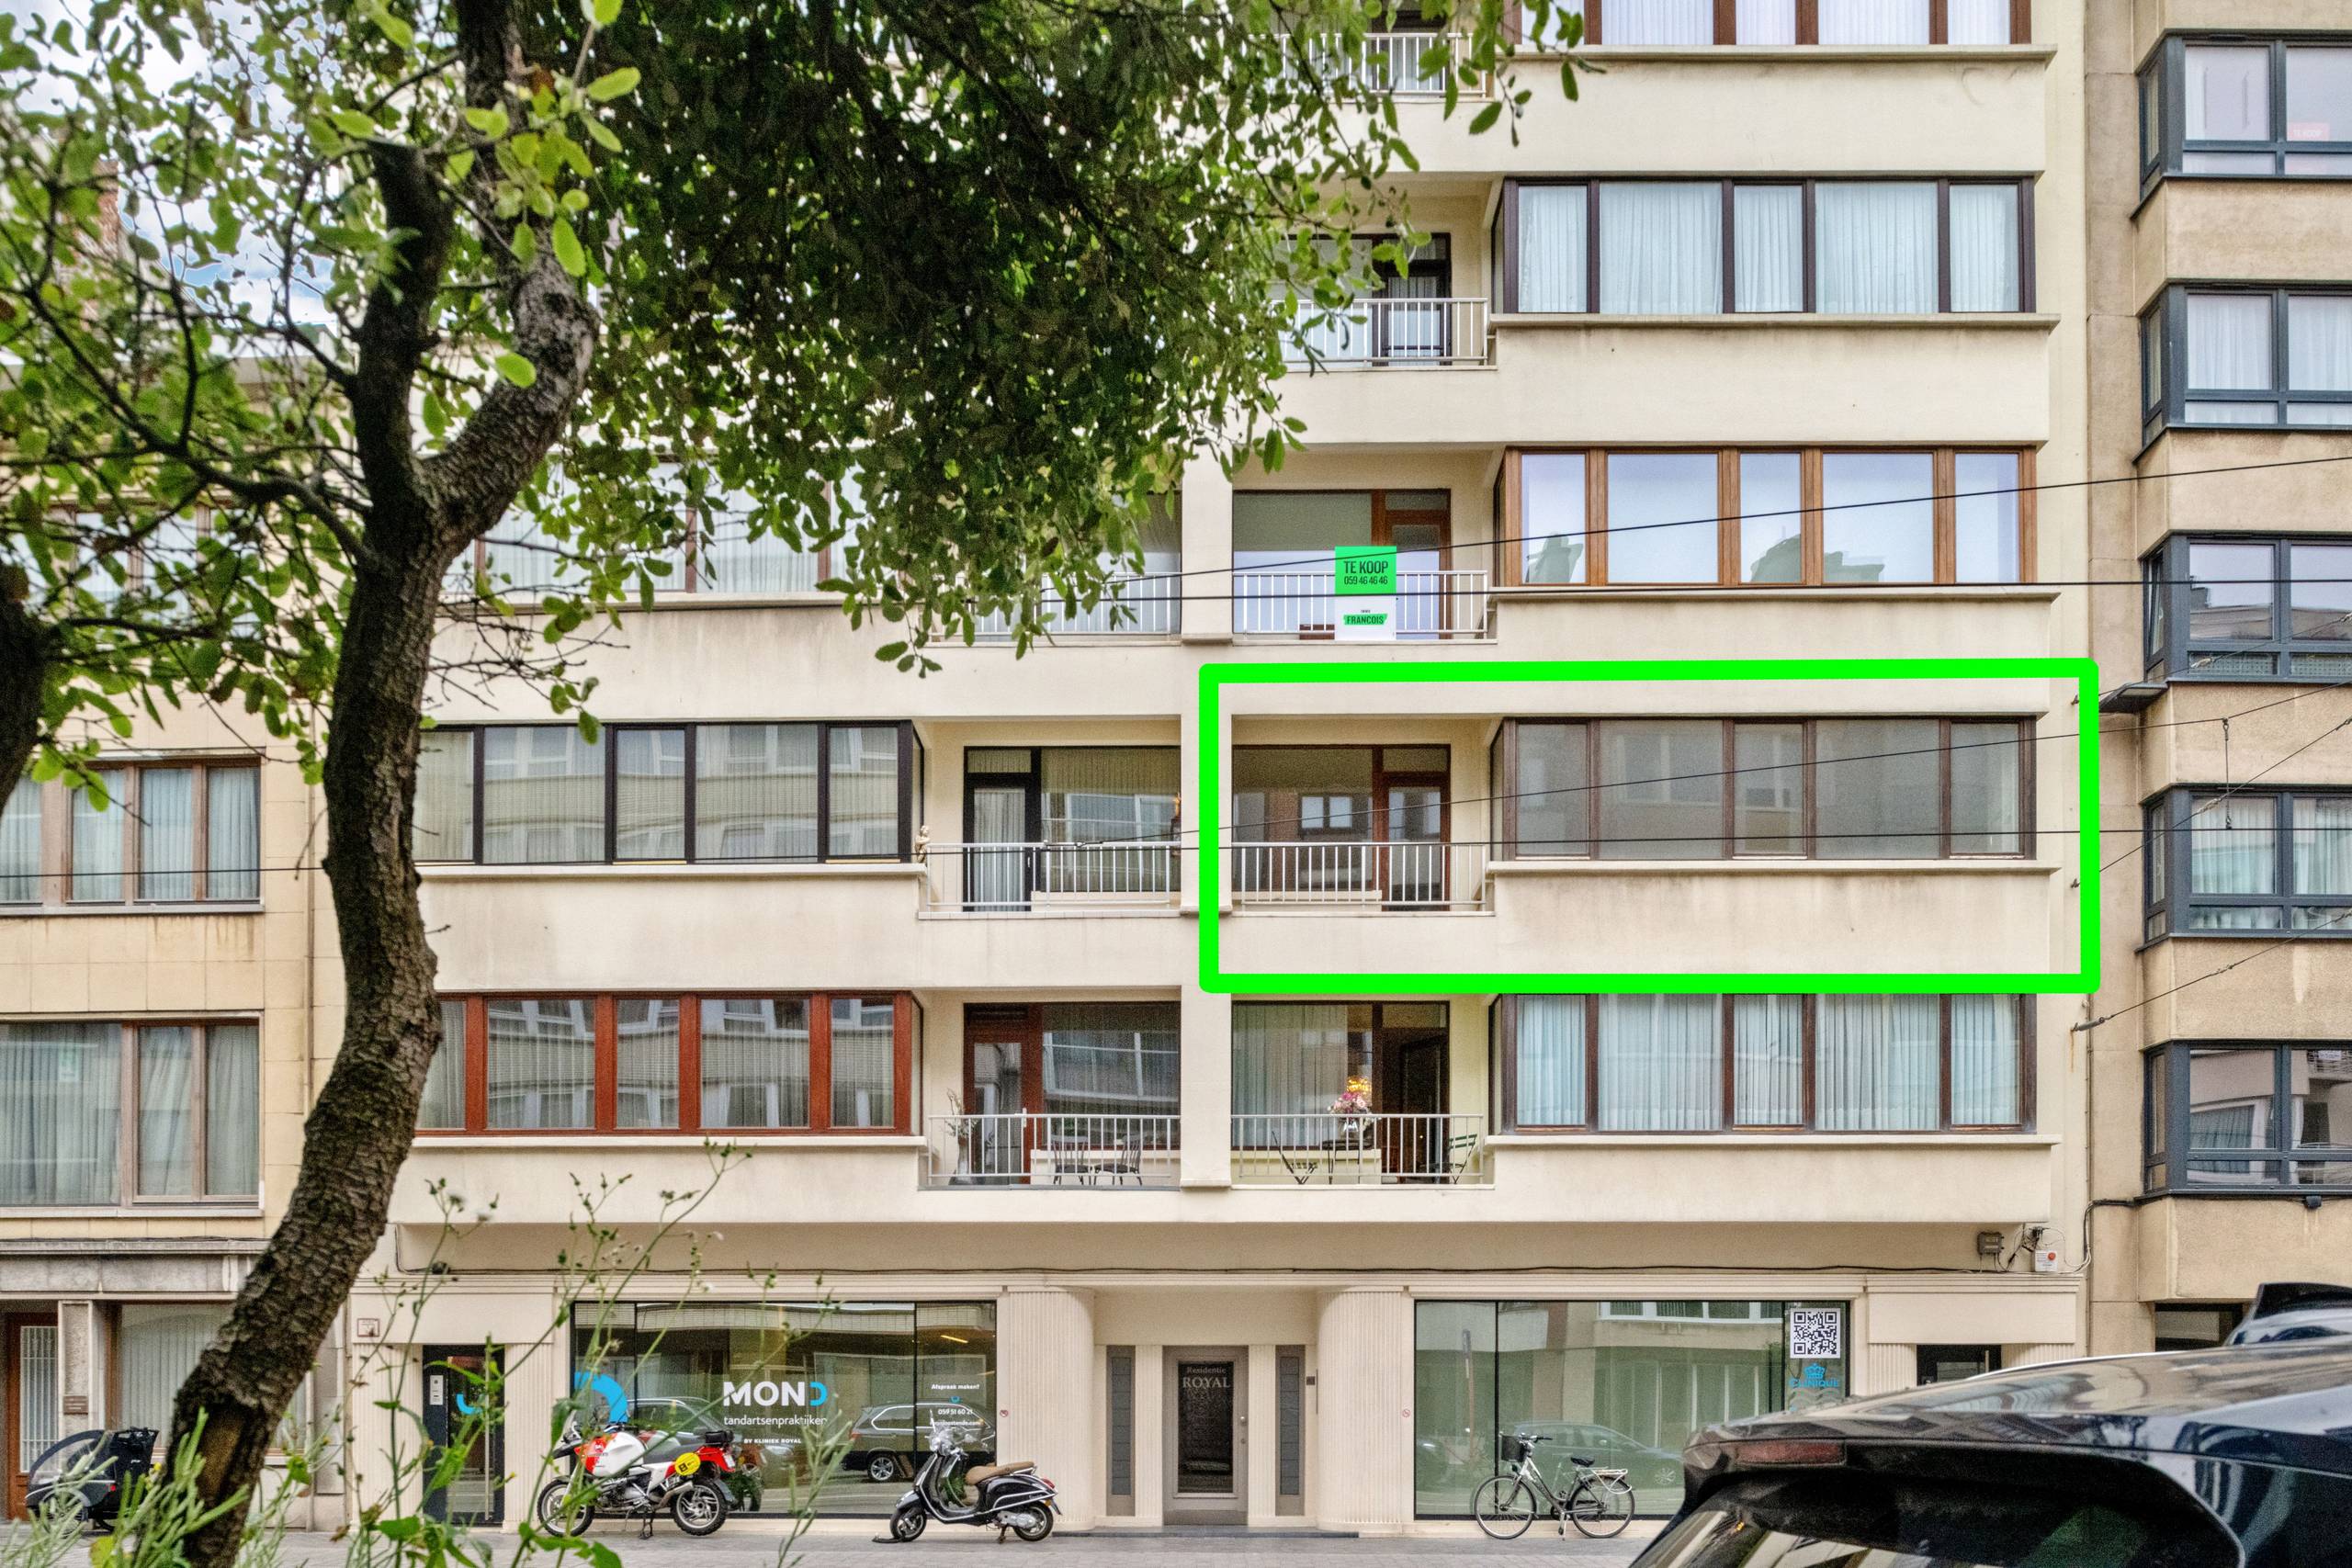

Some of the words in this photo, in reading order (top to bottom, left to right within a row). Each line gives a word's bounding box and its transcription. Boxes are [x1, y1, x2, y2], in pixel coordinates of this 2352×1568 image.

[1344, 561, 1356, 573] TE
[1360, 561, 1388, 573] KOOP
[1344, 576, 1357, 584] 059
[1359, 576, 1367, 584] 46
[1369, 576, 1377, 584] 46
[1379, 576, 1387, 584] 46
[1347, 615, 1384, 624] FRANCOIS
[1182, 1377, 1230, 1389] ROYAL
